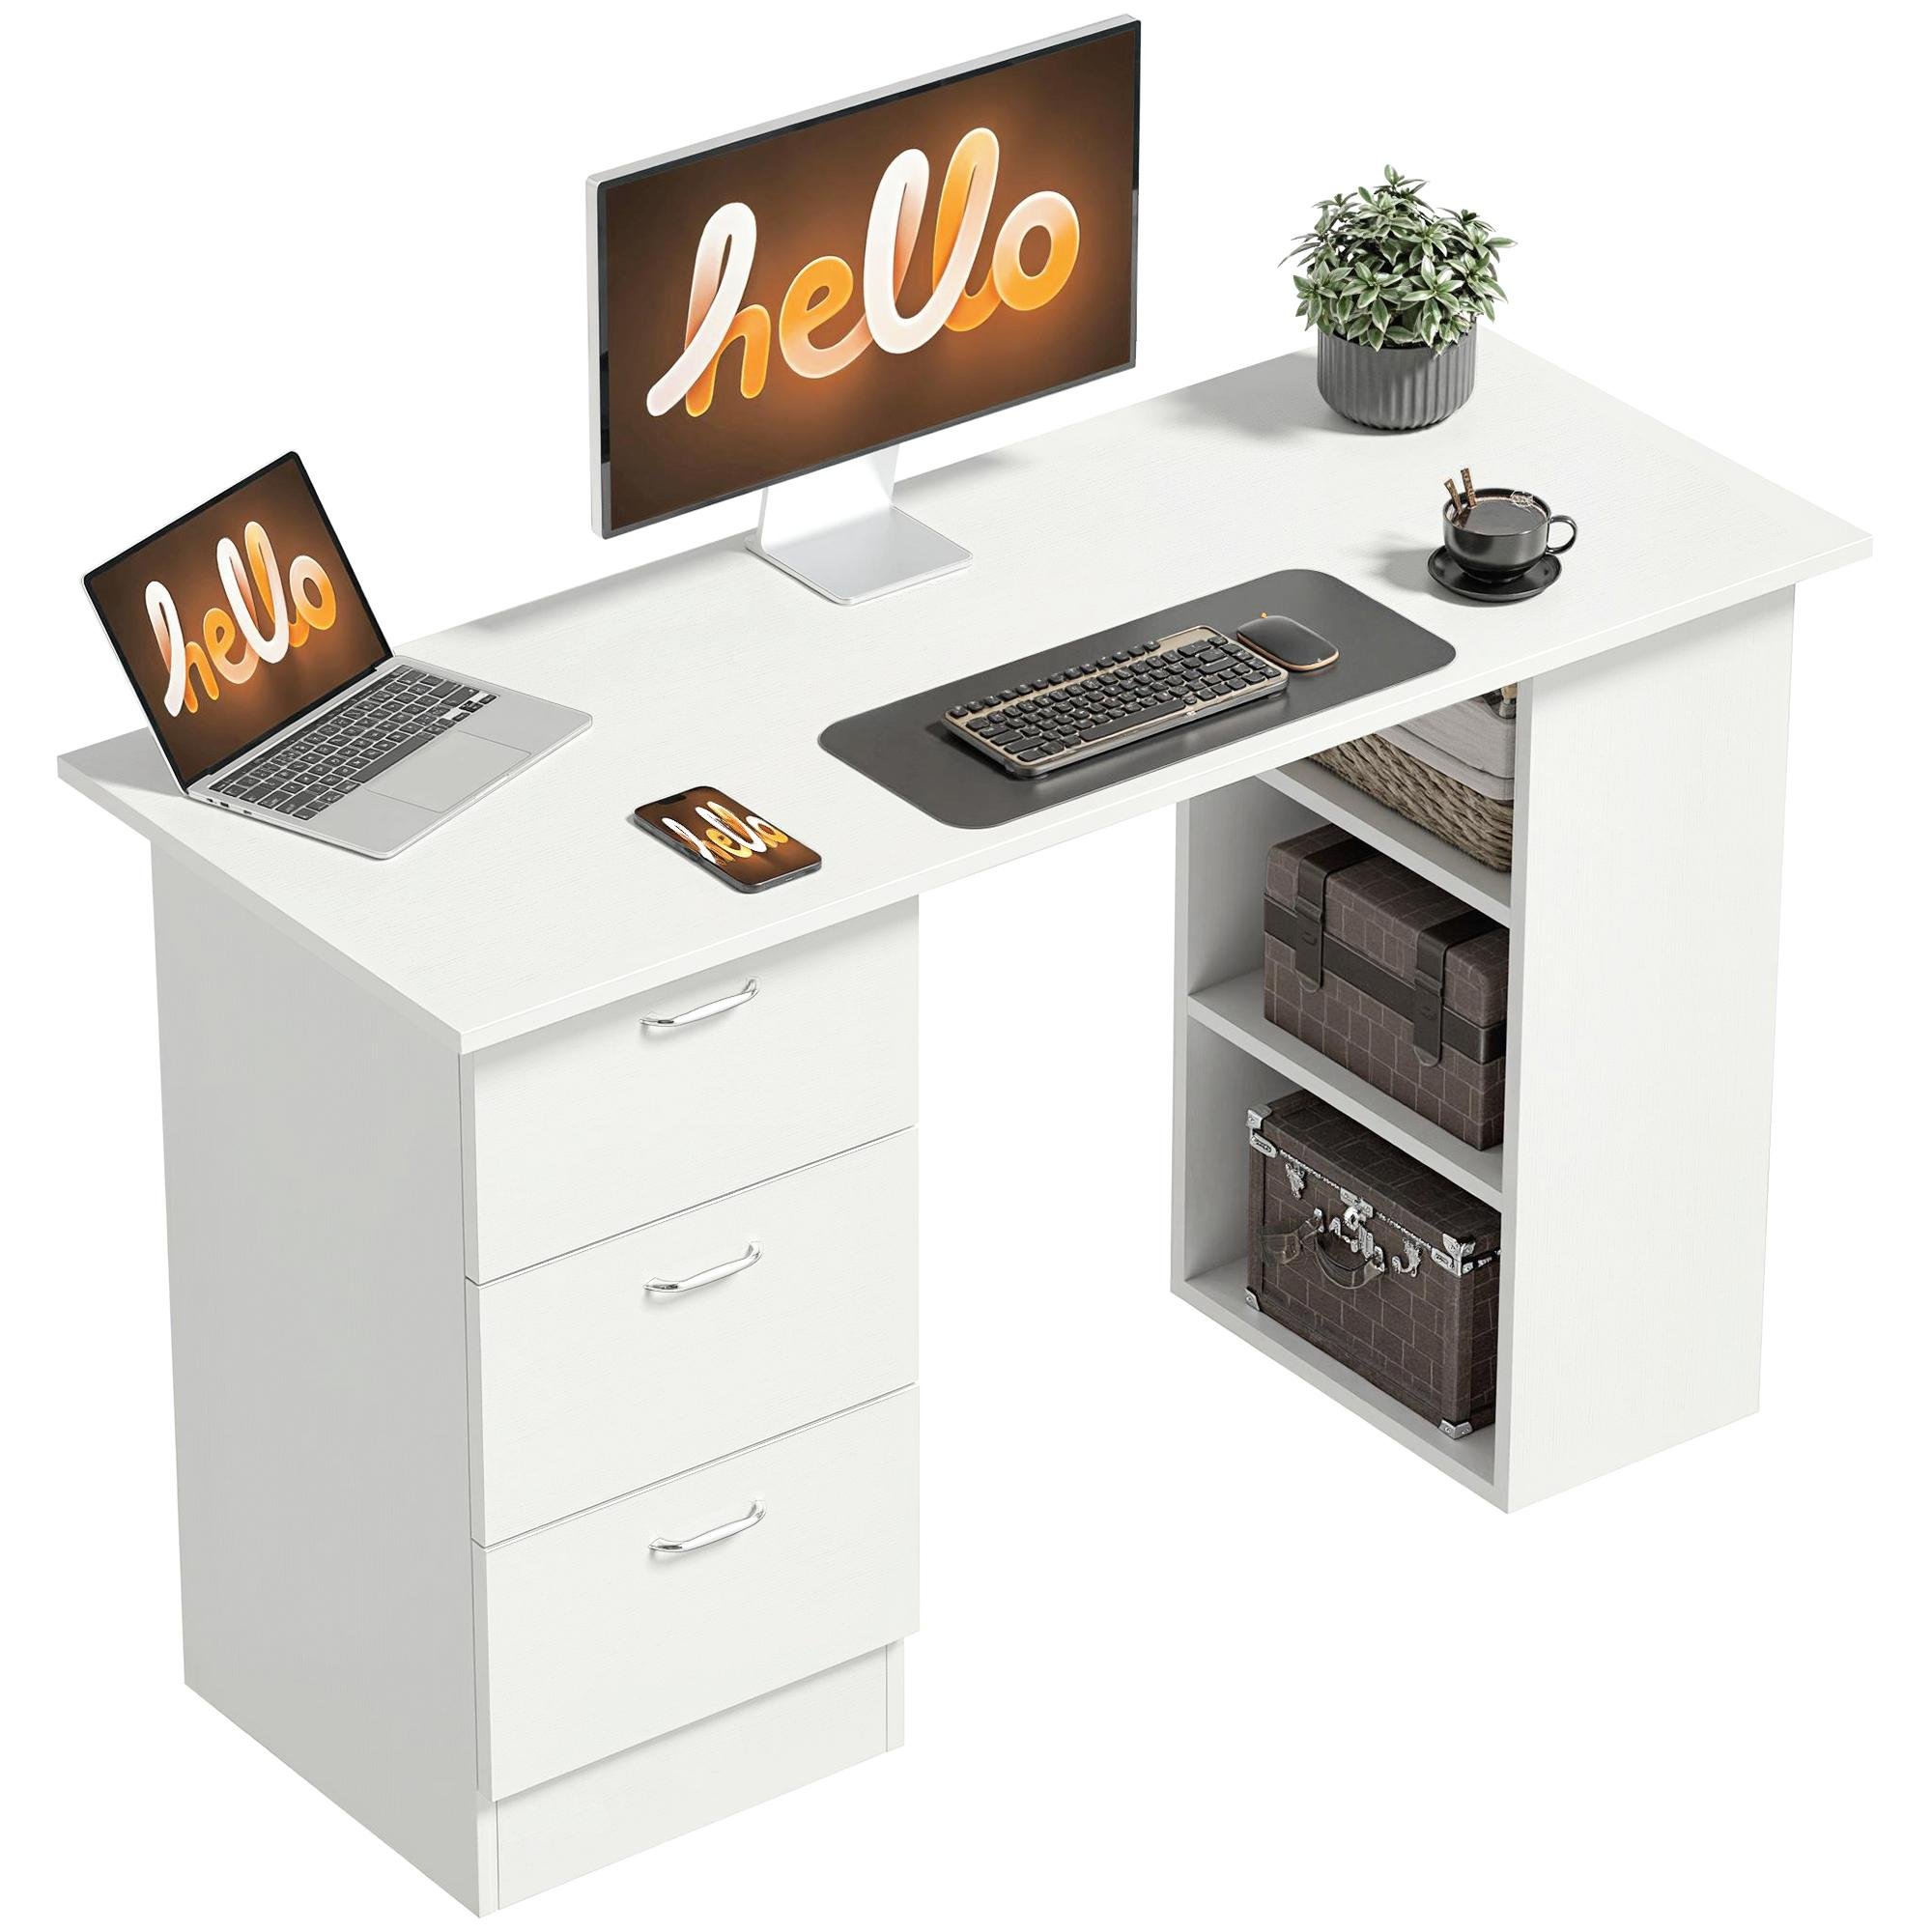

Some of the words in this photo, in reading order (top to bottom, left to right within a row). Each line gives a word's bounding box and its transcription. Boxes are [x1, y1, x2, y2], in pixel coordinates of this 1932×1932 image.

[646, 128, 1080, 417] hello
[145, 521, 336, 717] hello
[661, 801, 788, 867] hello
